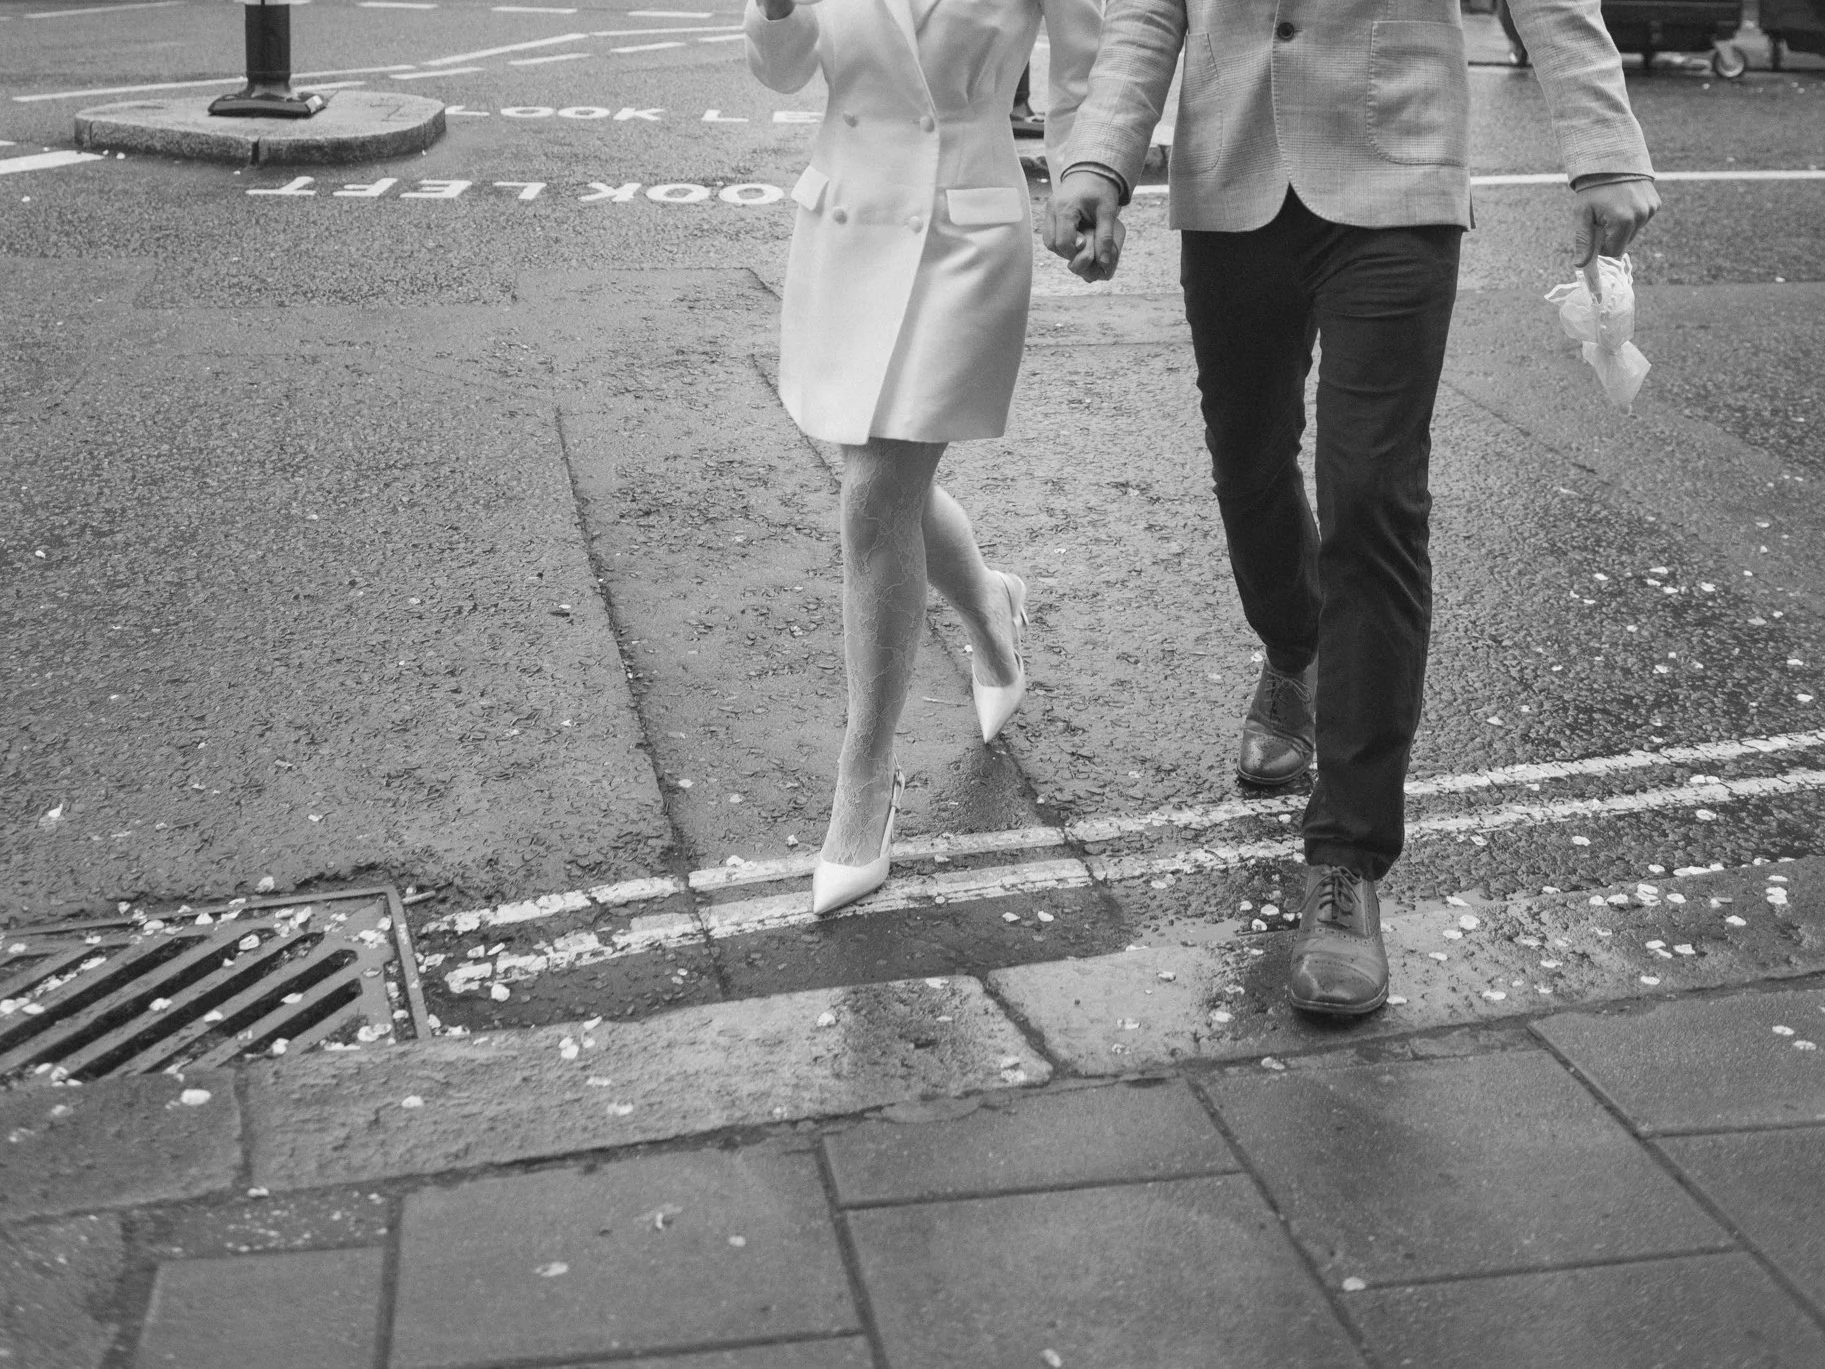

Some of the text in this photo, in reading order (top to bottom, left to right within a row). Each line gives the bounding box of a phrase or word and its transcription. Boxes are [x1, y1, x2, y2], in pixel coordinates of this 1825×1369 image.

[444, 105, 826, 124] LOOK LE
[245, 175, 786, 205] OOK LEFT
